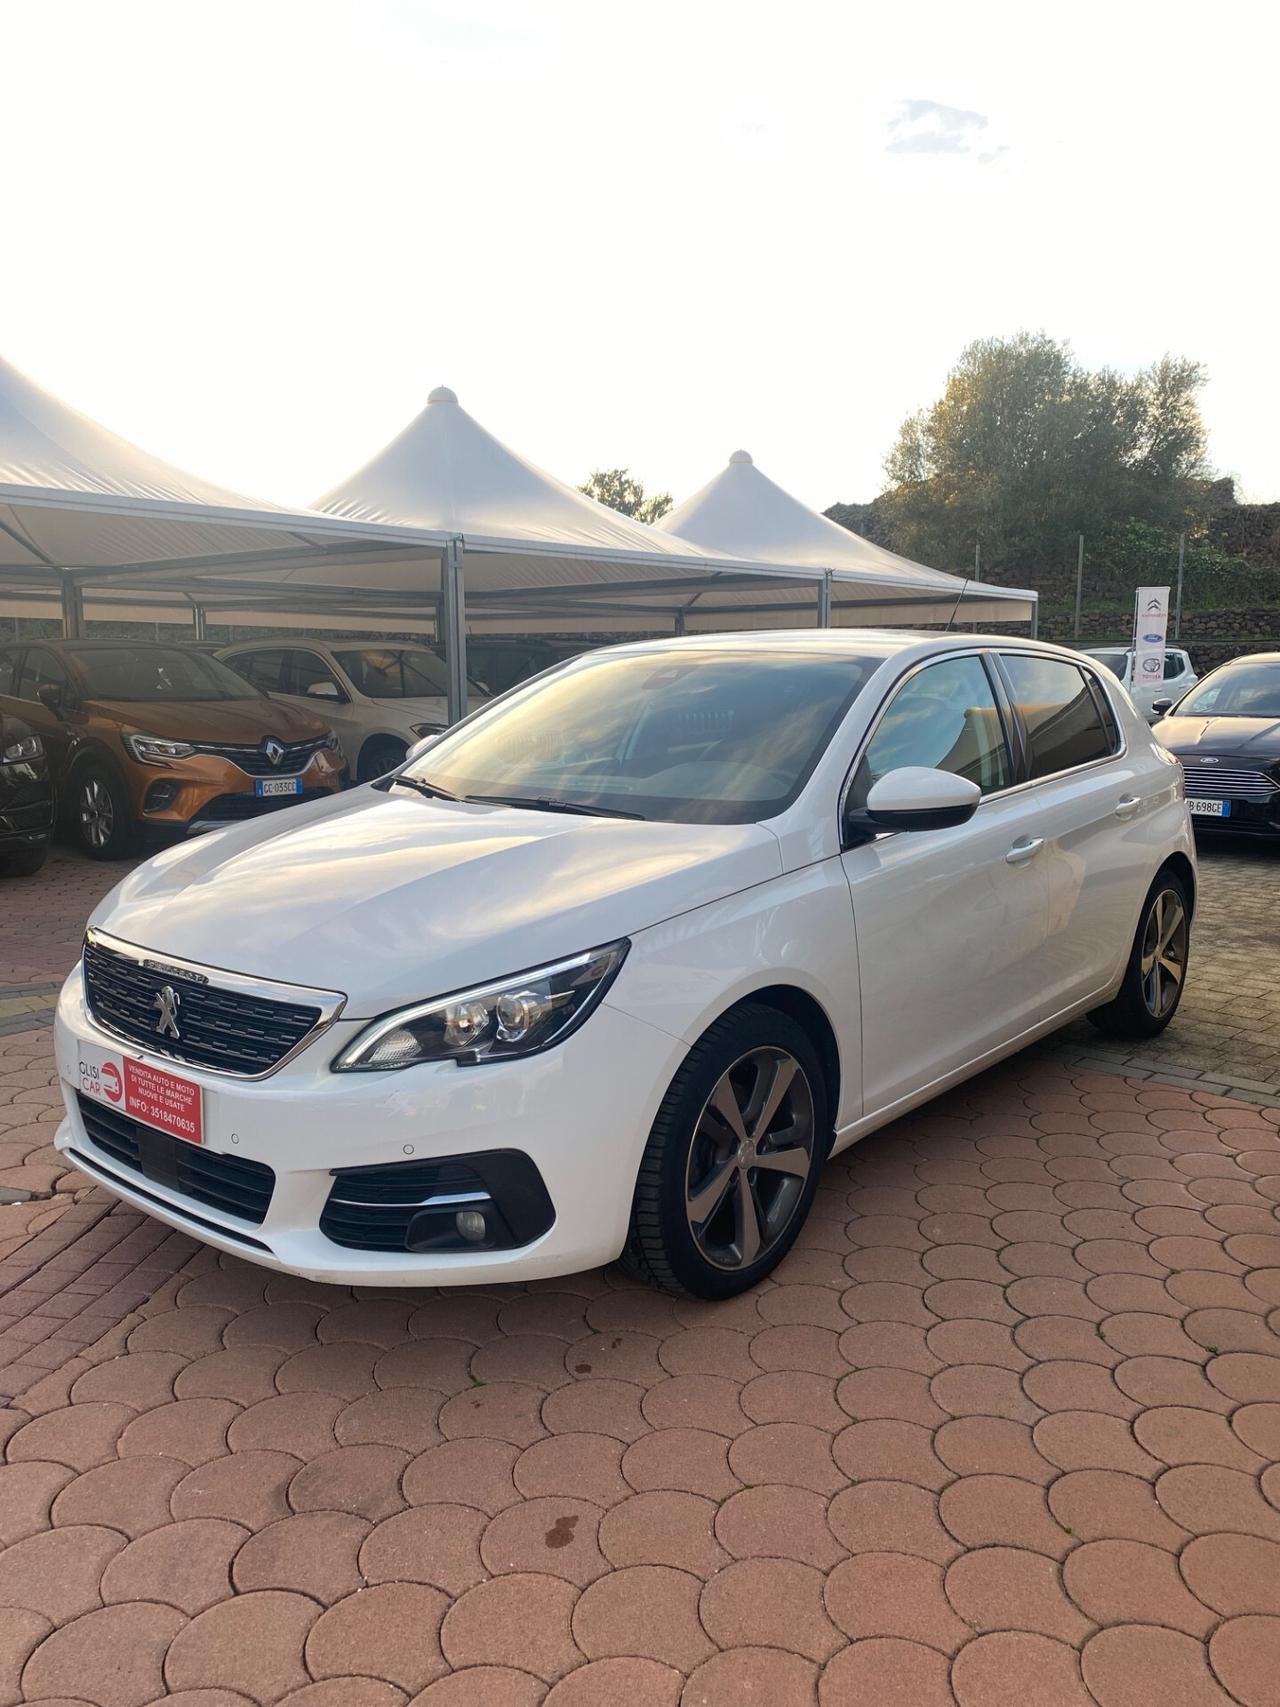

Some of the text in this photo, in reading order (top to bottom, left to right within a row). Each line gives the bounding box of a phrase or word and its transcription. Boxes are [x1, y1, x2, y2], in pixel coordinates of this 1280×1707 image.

[128, 1064, 152, 1080] VENDITA
[152, 1073, 170, 1087] AUTO
[176, 1082, 195, 1097] MOTO
[137, 1077, 156, 1092] TUTTE
[156, 1084, 165, 1094] LE
[165, 1087, 193, 1106] MARCHE
[129, 1095, 195, 1133] INFO: 3518470635
[138, 1086, 159, 1102] NUOVE
[164, 1096, 185, 1112] USATE
